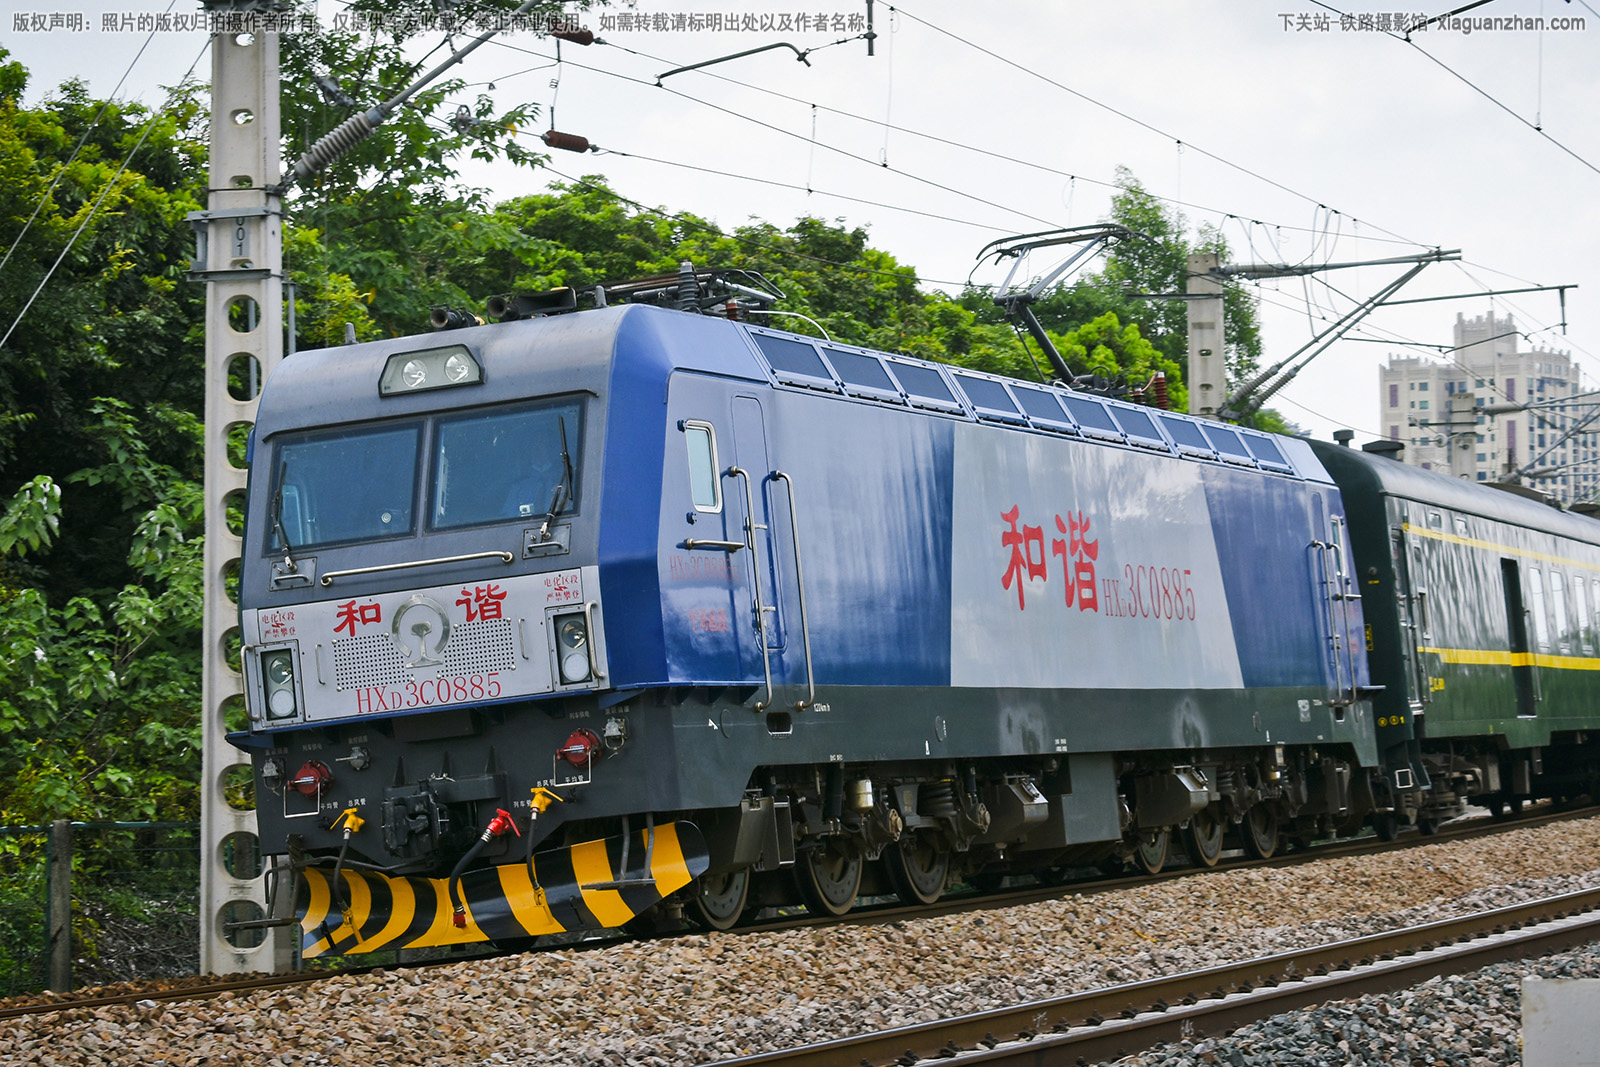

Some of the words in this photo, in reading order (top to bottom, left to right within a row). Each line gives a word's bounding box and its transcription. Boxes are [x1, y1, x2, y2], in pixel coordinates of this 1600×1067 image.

[1001, 504, 1098, 612] 和谐
[544, 574, 578, 587] 电化区段
[262, 611, 295, 624] 电化区段
[333, 599, 381, 637] 和
[456, 584, 507, 622] 谐
[356, 672, 502, 714] HXD3C0885
